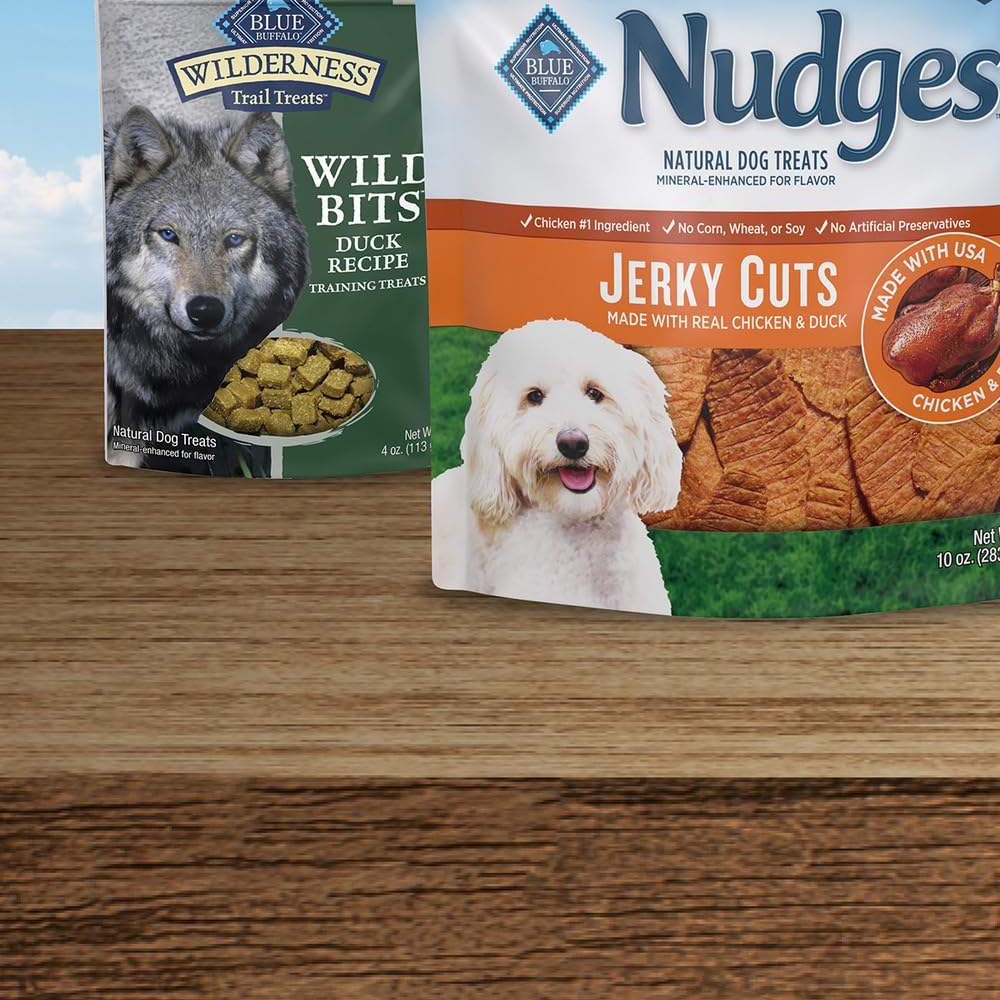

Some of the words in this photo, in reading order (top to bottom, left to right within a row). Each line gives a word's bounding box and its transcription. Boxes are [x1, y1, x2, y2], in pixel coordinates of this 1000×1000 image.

[250, 15, 304, 30] BLUE
[526, 59, 574, 75] BLUE
[231, 88, 269, 105] Trail
[664, 150, 732, 170] NATURAL
[739, 151, 768, 170] DOG
[775, 150, 828, 170] TREATS
[301, 153, 425, 187] WILD
[657, 175, 766, 186] MINERAL-ENHANCED
[770, 176, 790, 186] FOR
[794, 176, 835, 185] FLAVOR
[534, 217, 576, 229] Chicken
[579, 218, 590, 230] #1
[594, 219, 650, 233] Ingredient
[678, 222, 694, 233] No
[697, 222, 727, 236] Corn,
[730, 222, 768, 236] Wheat,
[771, 226, 783, 234] or
[786, 222, 806, 237] Soy
[830, 221, 846, 232] No
[849, 219, 895, 232] Artificial
[899, 218, 970, 231] Preservatives
[336, 234, 401, 252] DUCK
[328, 254, 408, 273] RECIPE
[309, 281, 376, 293] TRAINING
[379, 276, 426, 289] TREATS
[871, 269, 907, 321] MADE
[903, 242, 949, 272] WITH
[955, 242, 986, 263] USA
[608, 311, 647, 326] MADE
[652, 314, 687, 328] WITH
[692, 316, 728, 329] REAL
[732, 316, 791, 329] CHICKEN
[796, 316, 805, 329] &
[810, 314, 847, 328] DUCK
[913, 387, 986, 412] CHICKEN
[987, 378, 999, 391] &
[113, 425, 152, 441] Natural
[156, 431, 178, 447] Dog
[181, 434, 217, 448] Treats
[405, 429, 420, 440] Net
[974, 529, 995, 545] Net
[937, 552, 952, 567] 10
[956, 553, 974, 565] oz.
